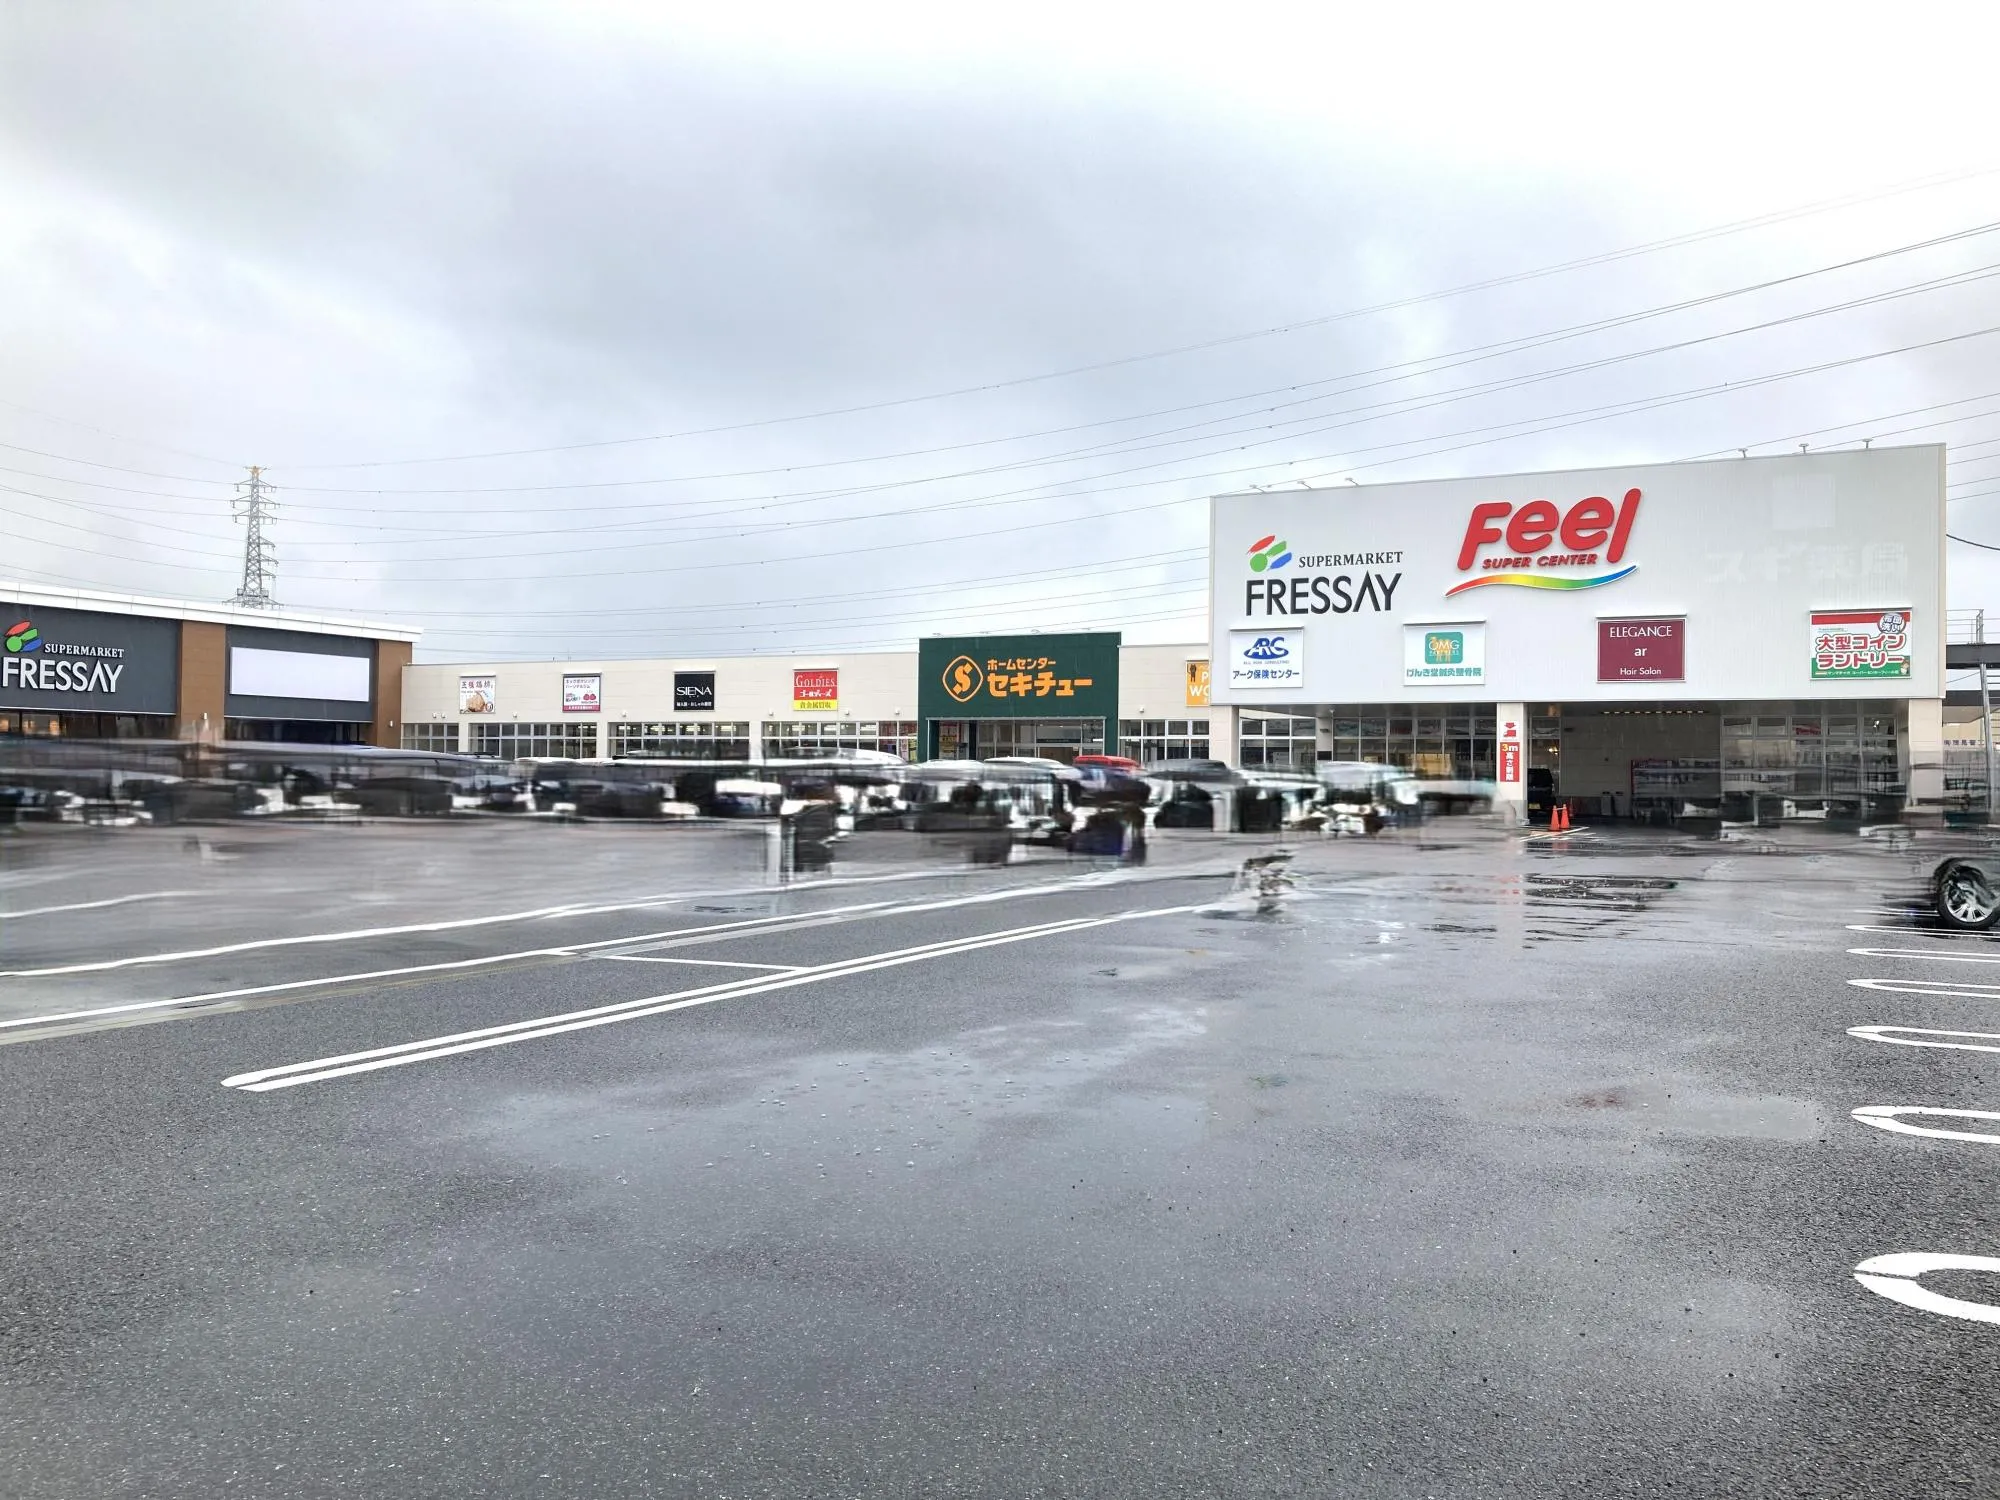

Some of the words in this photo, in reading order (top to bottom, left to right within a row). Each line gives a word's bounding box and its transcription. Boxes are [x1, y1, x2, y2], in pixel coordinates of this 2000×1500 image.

[1457, 488, 1642, 571] Feel
[1298, 552, 1404, 568] SUPERMARKET
[1482, 557, 1533, 570] SUPER
[1537, 553, 1598, 567] CENTER
[1246, 570, 1402, 616] FRESSAY
[1609, 625, 1673, 638] ELEGANCE
[44, 642, 125, 659] SUPERMARKET
[1428, 638, 1461, 651] OMG
[1817, 634, 1906, 652] 大型コイン
[1634, 647, 1648, 657] ar
[987, 657, 1057, 671] ホームセンター
[1817, 653, 1904, 669] ランドリー
[2, 656, 124, 693] FRESSAY
[1233, 669, 1300, 680] アーク保険センター
[1620, 667, 1637, 676] Hair
[1639, 666, 1662, 675] Salon
[795, 674, 836, 687] GOLDIES
[987, 672, 1093, 697] セキチュー
[676, 686, 712, 696] SIENA
[1501, 743, 1519, 752] 3m
